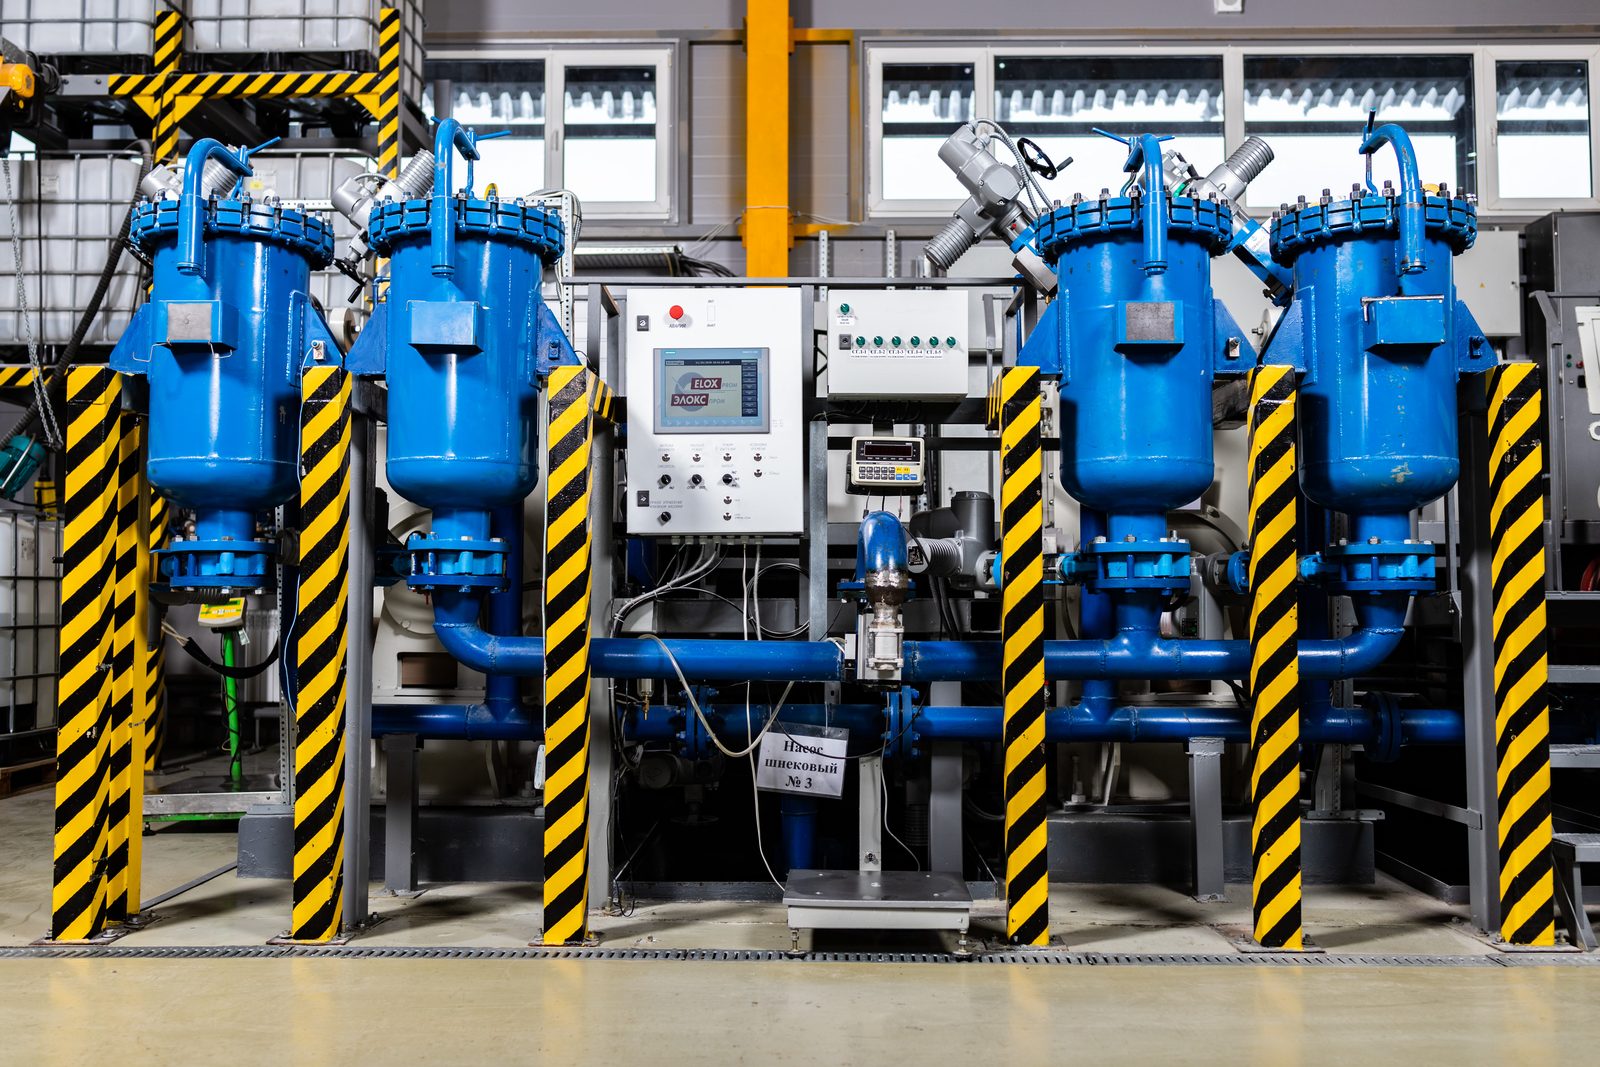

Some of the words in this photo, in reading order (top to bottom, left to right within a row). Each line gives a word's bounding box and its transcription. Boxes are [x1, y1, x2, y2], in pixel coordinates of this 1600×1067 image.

[694, 379, 718, 389] ELOX
[673, 395, 706, 405] ЭЛОКС
[783, 740, 824, 755] Насос
[764, 758, 838, 774] шнековый
[785, 775, 802, 788] №
[804, 777, 813, 789] 3
